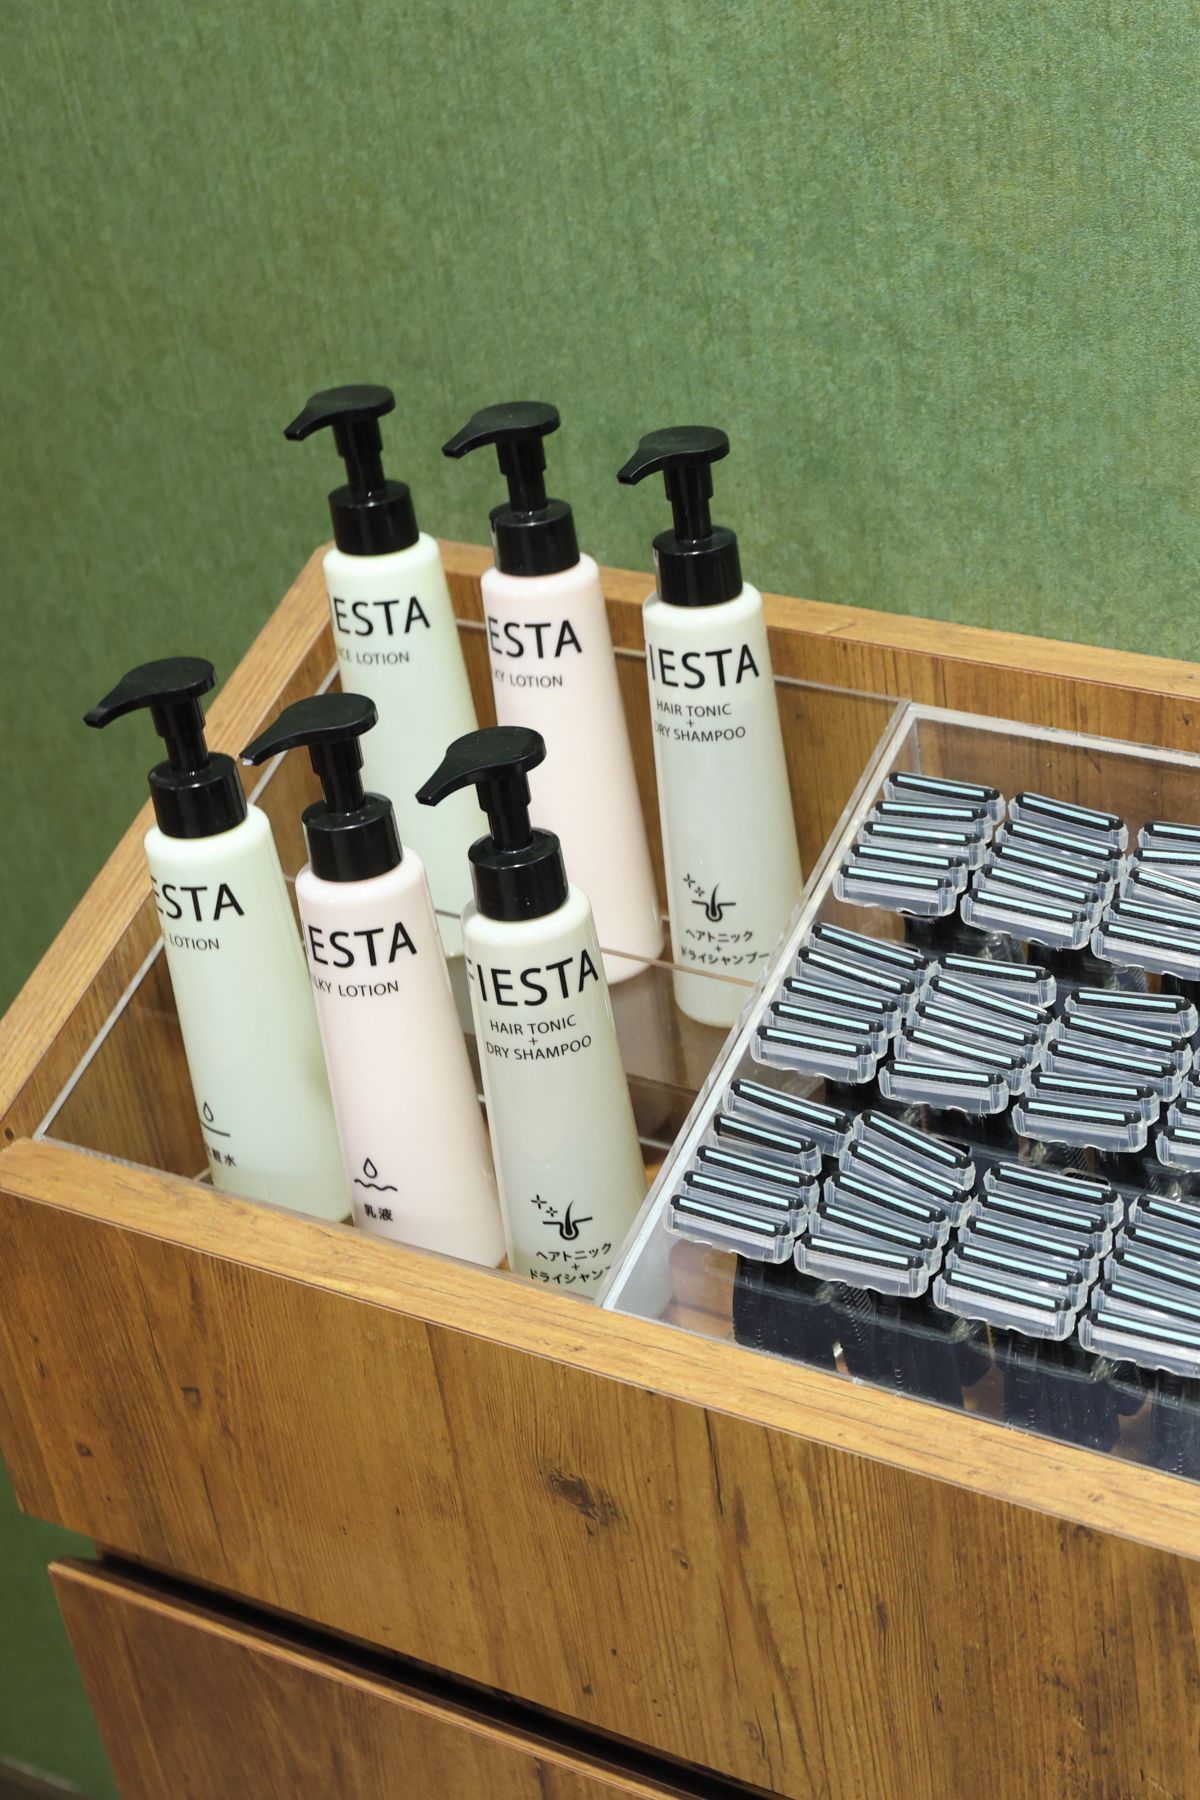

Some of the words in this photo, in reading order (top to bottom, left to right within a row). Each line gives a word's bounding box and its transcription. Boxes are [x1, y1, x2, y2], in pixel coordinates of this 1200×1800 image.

[333, 595, 431, 636] ESTA
[487, 615, 582, 659] ESTA
[355, 651, 410, 665] LOTION
[649, 643, 760, 690] IESTA
[509, 673, 563, 688] LOTION
[656, 699, 683, 716] HAIR
[685, 703, 732, 718] TONIC
[673, 726, 746, 742] SHAMPOO
[168, 932, 220, 951] LOTION
[307, 921, 418, 968] ESTA
[313, 975, 332, 995] LKY
[338, 980, 399, 998] LOTION
[490, 1019, 524, 1035] HAIR
[527, 1014, 577, 1035] TONIC
[486, 1041, 509, 1059] DRY
[513, 1035, 592, 1061] SHAMPOO
[536, 1243, 612, 1262] ヘアトニック
[529, 1266, 611, 1284] ドライシャン
